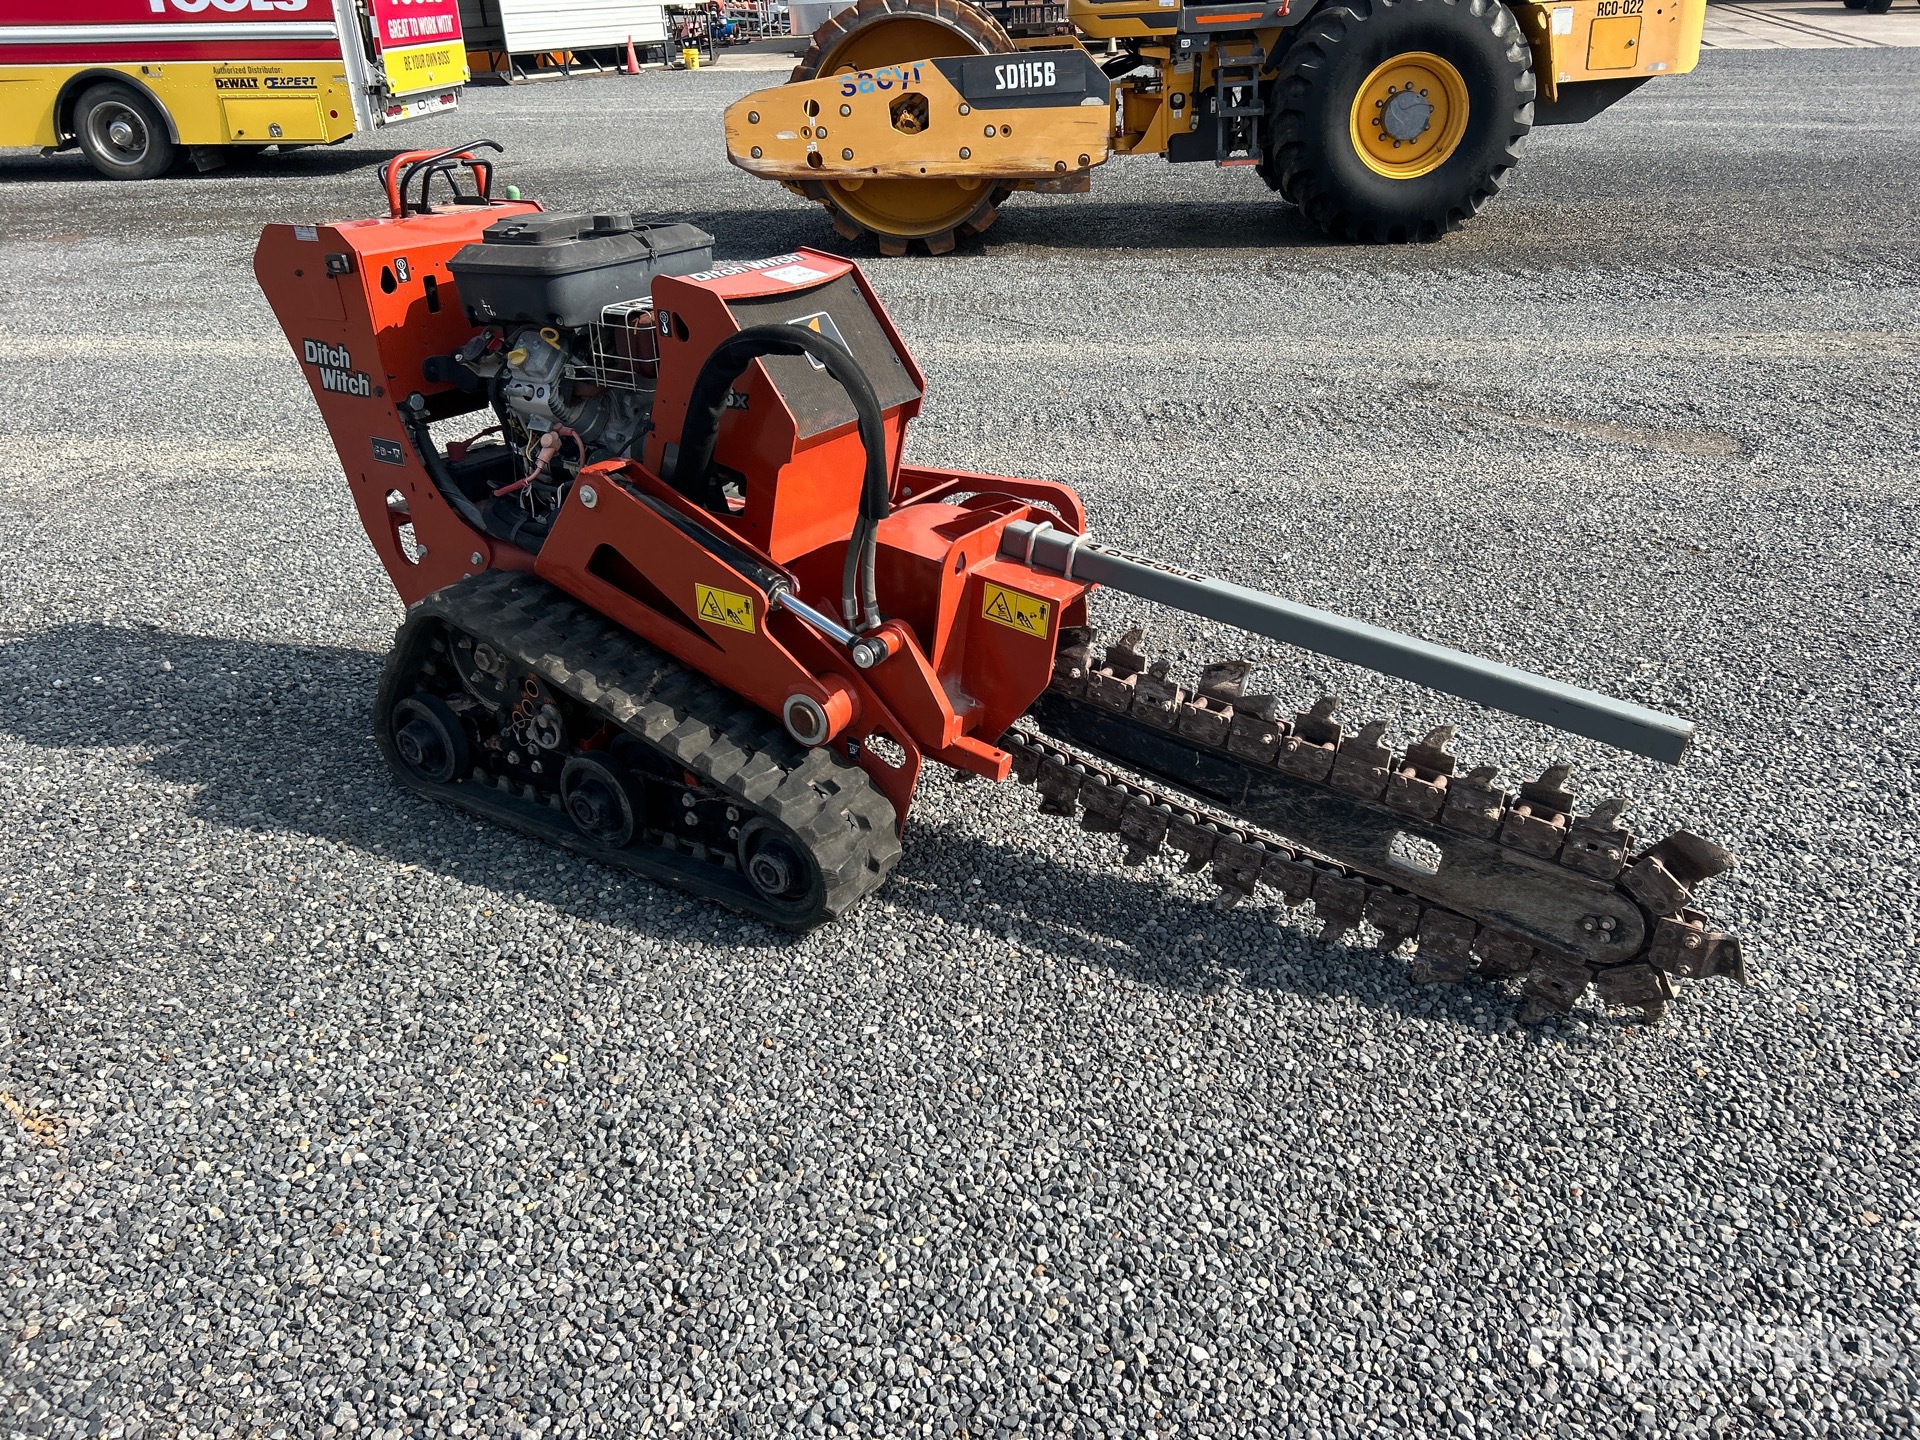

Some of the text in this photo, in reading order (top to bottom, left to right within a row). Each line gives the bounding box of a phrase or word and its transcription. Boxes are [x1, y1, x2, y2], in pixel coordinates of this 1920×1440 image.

[388, 17, 410, 39] GREAT
[409, 17, 420, 37] TO
[418, 15, 439, 36] WORK
[213, 65, 284, 75] Authorized Distributor:
[404, 56, 412, 71] BE
[411, 53, 427, 70] YOUR
[425, 52, 438, 68] OWN
[994, 61, 1057, 90] SD115B
[838, 62, 925, 97] sacyr
[688, 263, 750, 282] Ditch
[744, 253, 804, 271] Witch
[304, 340, 351, 369] Ditch
[320, 367, 370, 397] Witch
[1104, 549, 1207, 582] DANGER
